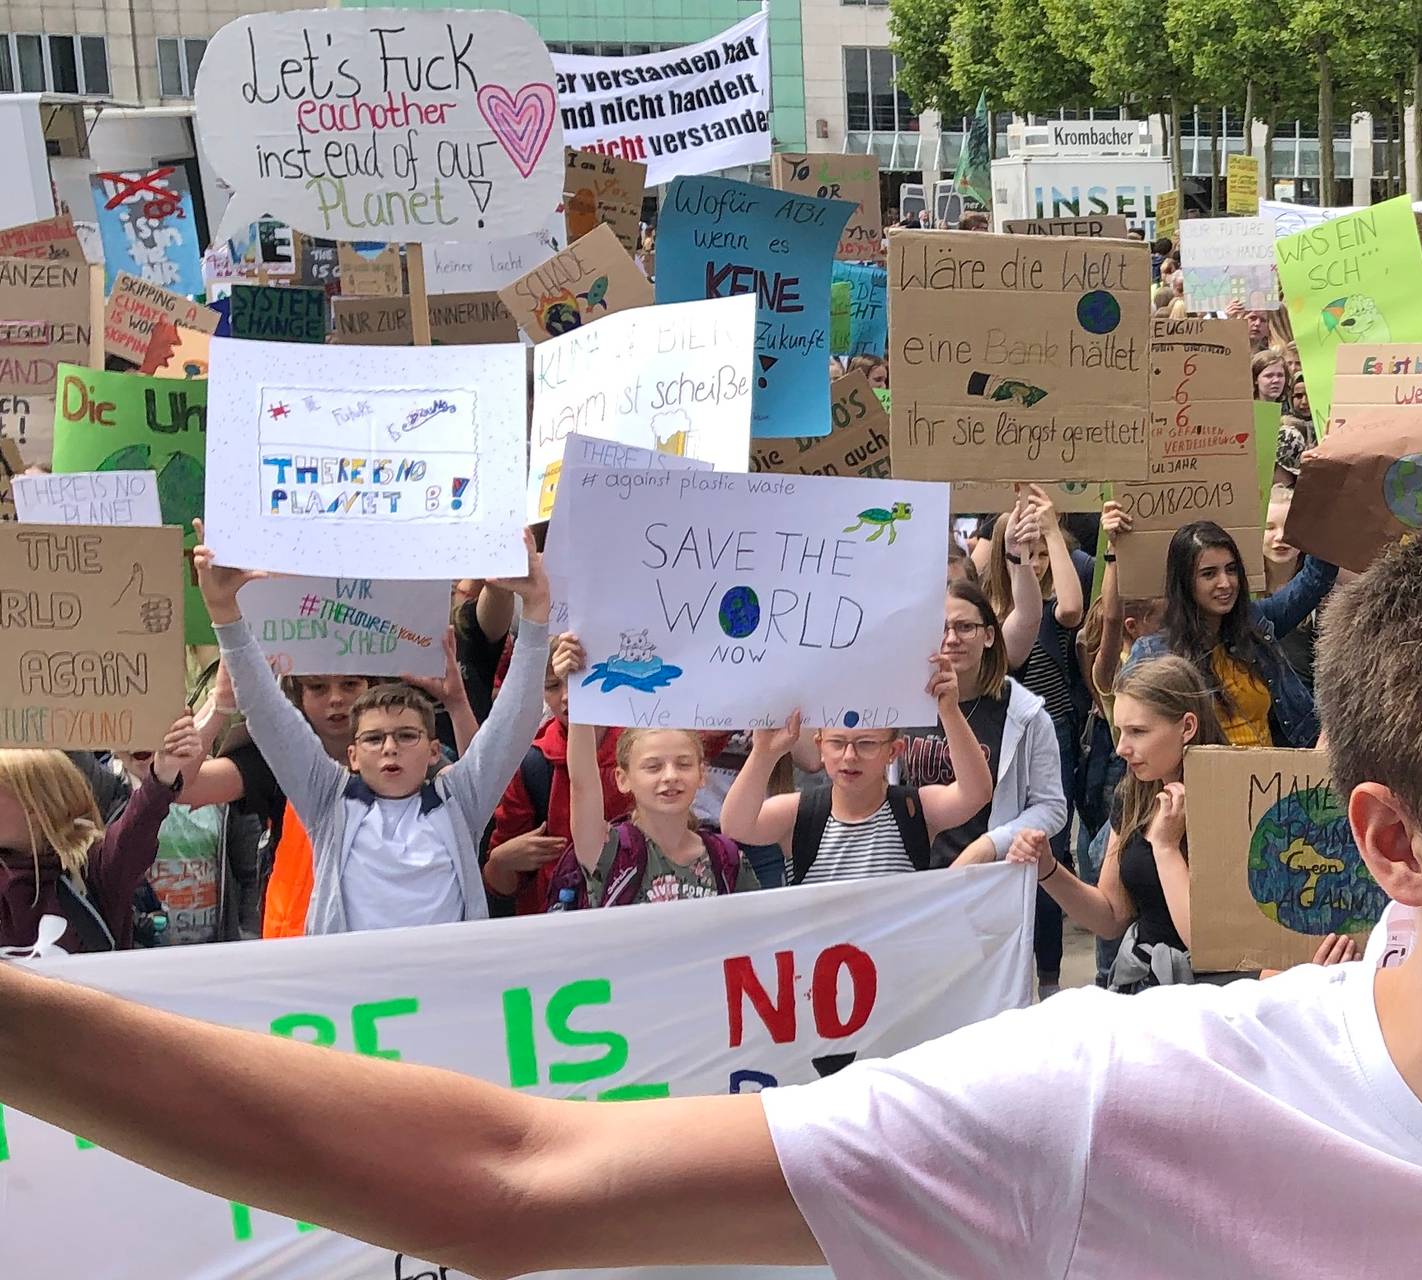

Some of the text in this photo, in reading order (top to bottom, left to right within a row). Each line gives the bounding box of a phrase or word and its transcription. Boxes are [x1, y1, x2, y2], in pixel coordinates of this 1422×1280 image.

[242, 26, 361, 103] Let's
[580, 35, 760, 92] verstanden hat
[297, 91, 457, 133] eachother
[601, 93, 666, 125] nicht
[1054, 126, 1134, 146] Krombacher
[256, 124, 498, 191] instead of our
[675, 180, 758, 224] Wofür
[817, 183, 841, 199] OR
[1034, 186, 1157, 218] INSEL
[769, 238, 790, 253] es
[1276, 212, 1377, 264] WAS EIN
[433, 247, 473, 273] keiner
[899, 244, 986, 292] Wäre
[999, 247, 1044, 290] die
[1061, 248, 1129, 292] Welt
[119, 276, 176, 312] SKIPPING
[232, 288, 324, 316] SYSTEM
[705, 261, 804, 313] KEINE
[110, 309, 123, 325] IS
[234, 311, 319, 338] CHANGE
[339, 313, 370, 335] NUR
[754, 321, 825, 356] Zukunft
[902, 332, 972, 365] eine
[983, 327, 1059, 366] Bank
[1183, 353, 1198, 377] 6
[1362, 355, 1383, 376] Es
[1387, 354, 1411, 375] ist
[650, 364, 749, 410] scheiße
[1175, 378, 1190, 405] 6
[906, 400, 945, 447] ihr
[995, 411, 1056, 462] längst
[1175, 404, 1192, 428] 6
[844, 427, 889, 468] auch
[262, 453, 367, 486] THERE
[395, 457, 427, 483] NO
[605, 470, 671, 500] against
[679, 471, 736, 500] plastic
[116, 474, 146, 498] NO
[271, 489, 401, 514] PLANET
[16, 532, 103, 574] THE
[641, 523, 857, 577] SAVE THE
[335, 577, 374, 600] WIR
[656, 578, 864, 651] WORLD
[709, 645, 767, 665] NOW
[628, 697, 900, 729] We have only WORLD
[1286, 850, 1340, 875] Green
[504, 943, 879, 1090] IS NO
